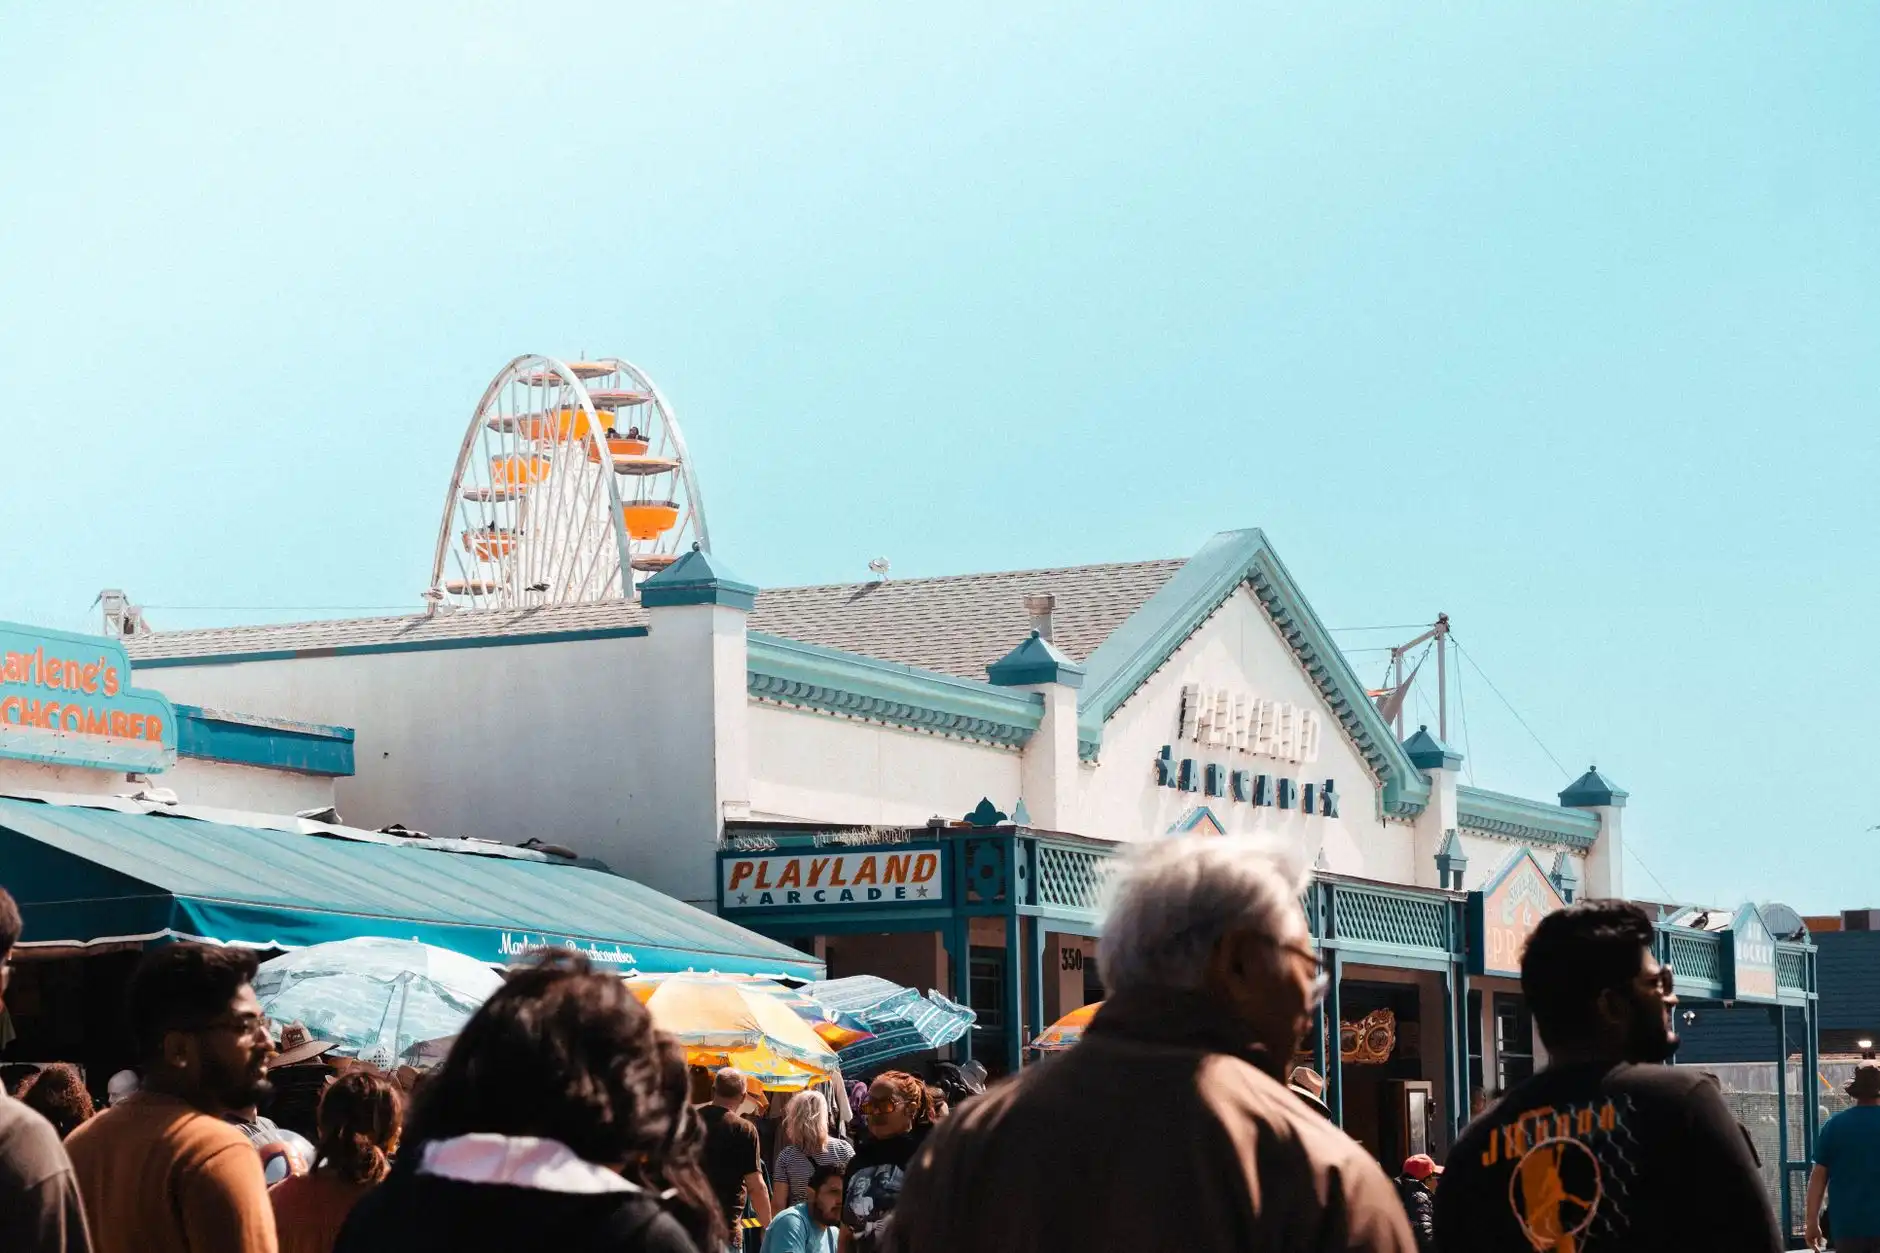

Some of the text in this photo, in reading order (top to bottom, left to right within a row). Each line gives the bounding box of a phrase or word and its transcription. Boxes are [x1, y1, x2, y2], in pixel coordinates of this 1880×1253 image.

[0, 645, 119, 697] arlene's
[0, 695, 163, 742] CHCOMBER
[729, 853, 937, 891] PLAYLAND
[759, 886, 906, 905] ARCADE
[1061, 948, 1083, 971] 350
